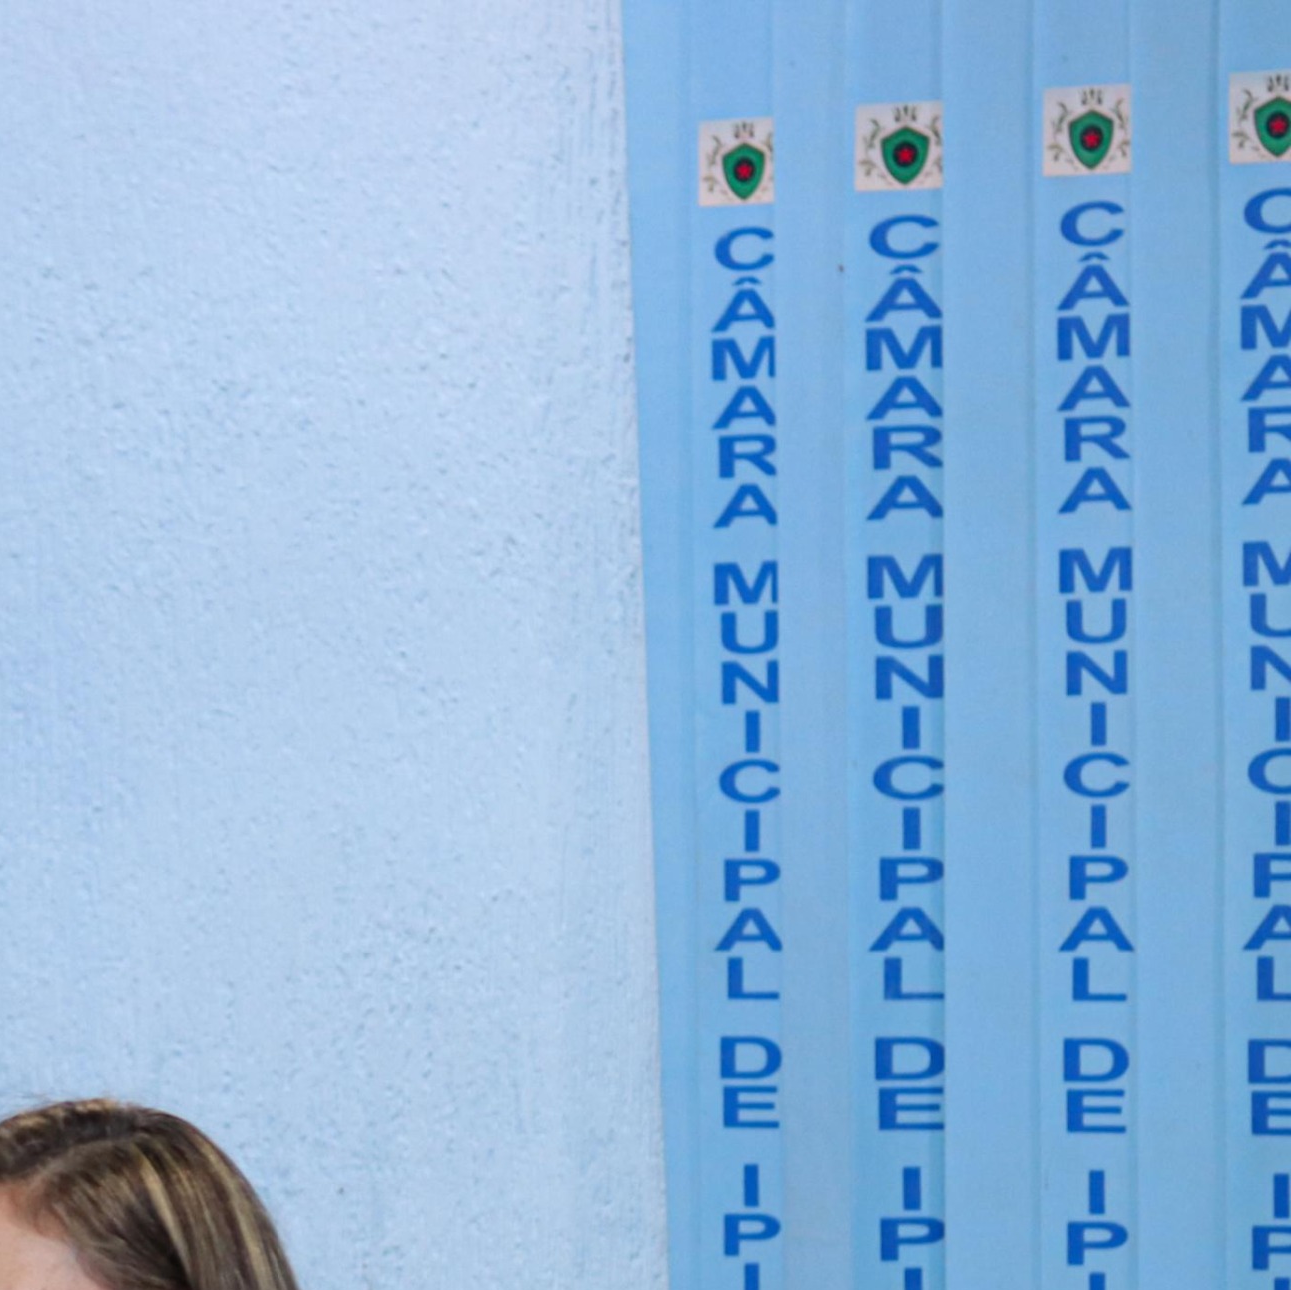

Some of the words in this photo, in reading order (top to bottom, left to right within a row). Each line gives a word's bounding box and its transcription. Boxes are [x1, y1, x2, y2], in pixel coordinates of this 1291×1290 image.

[711, 226, 778, 530] CÂMARA
[864, 214, 944, 522] CÂMARA
[1056, 201, 1132, 515] CÂMARA
[711, 560, 783, 1001] MUNICIPAL
[866, 553, 945, 1002] MUNICIPAL
[1058, 546, 1135, 1003] MUNICIPAL
[719, 1035, 783, 1130] DE
[874, 1036, 946, 1132] DE
[1062, 1037, 1130, 1135] DE
